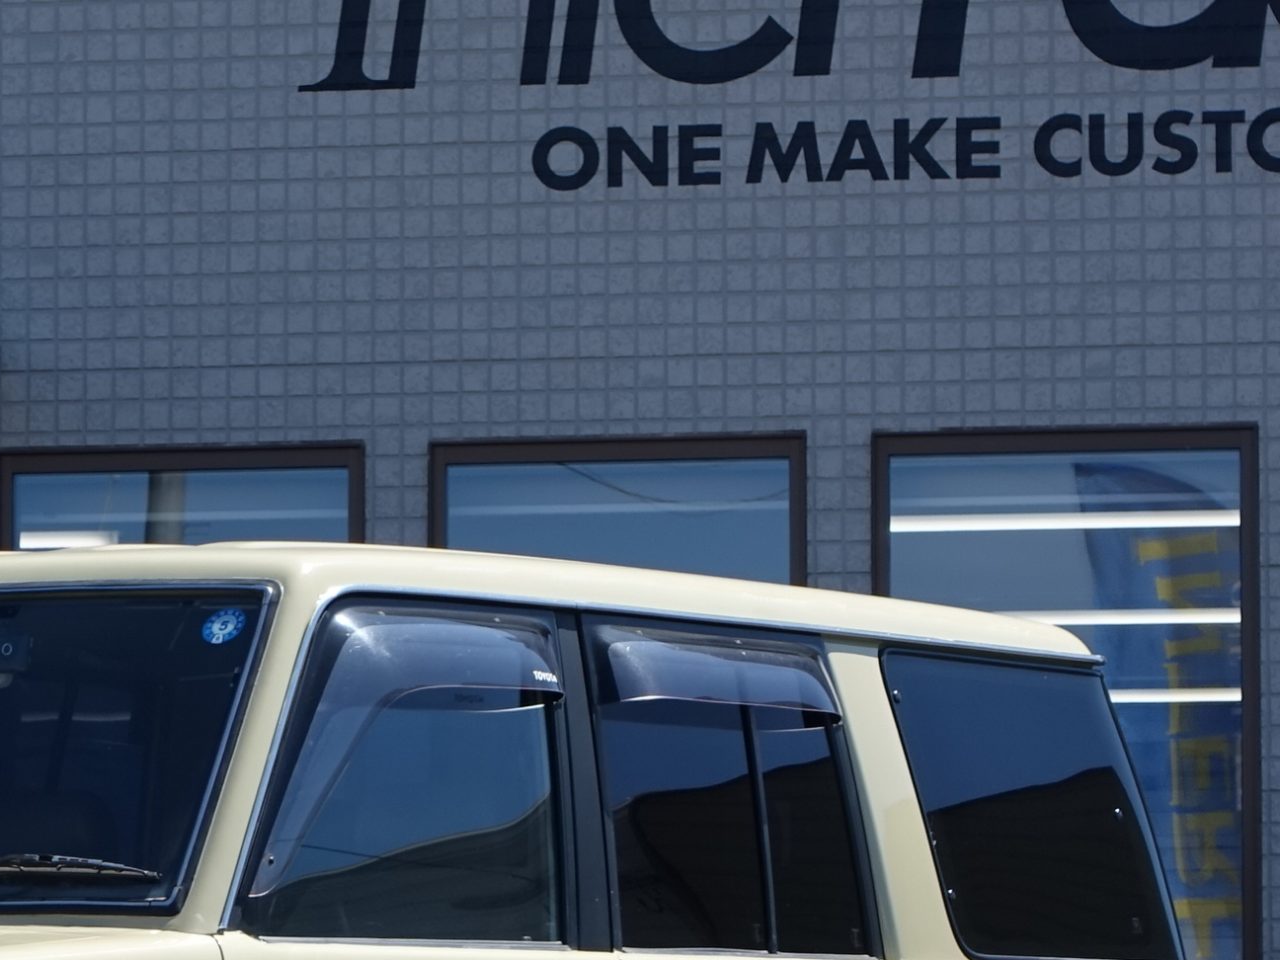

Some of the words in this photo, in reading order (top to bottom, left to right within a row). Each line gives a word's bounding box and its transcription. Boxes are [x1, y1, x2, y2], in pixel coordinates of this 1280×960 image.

[531, 126, 722, 191] ONE
[745, 116, 1001, 184] MAKE
[532, 670, 558, 684] TOYOTA
